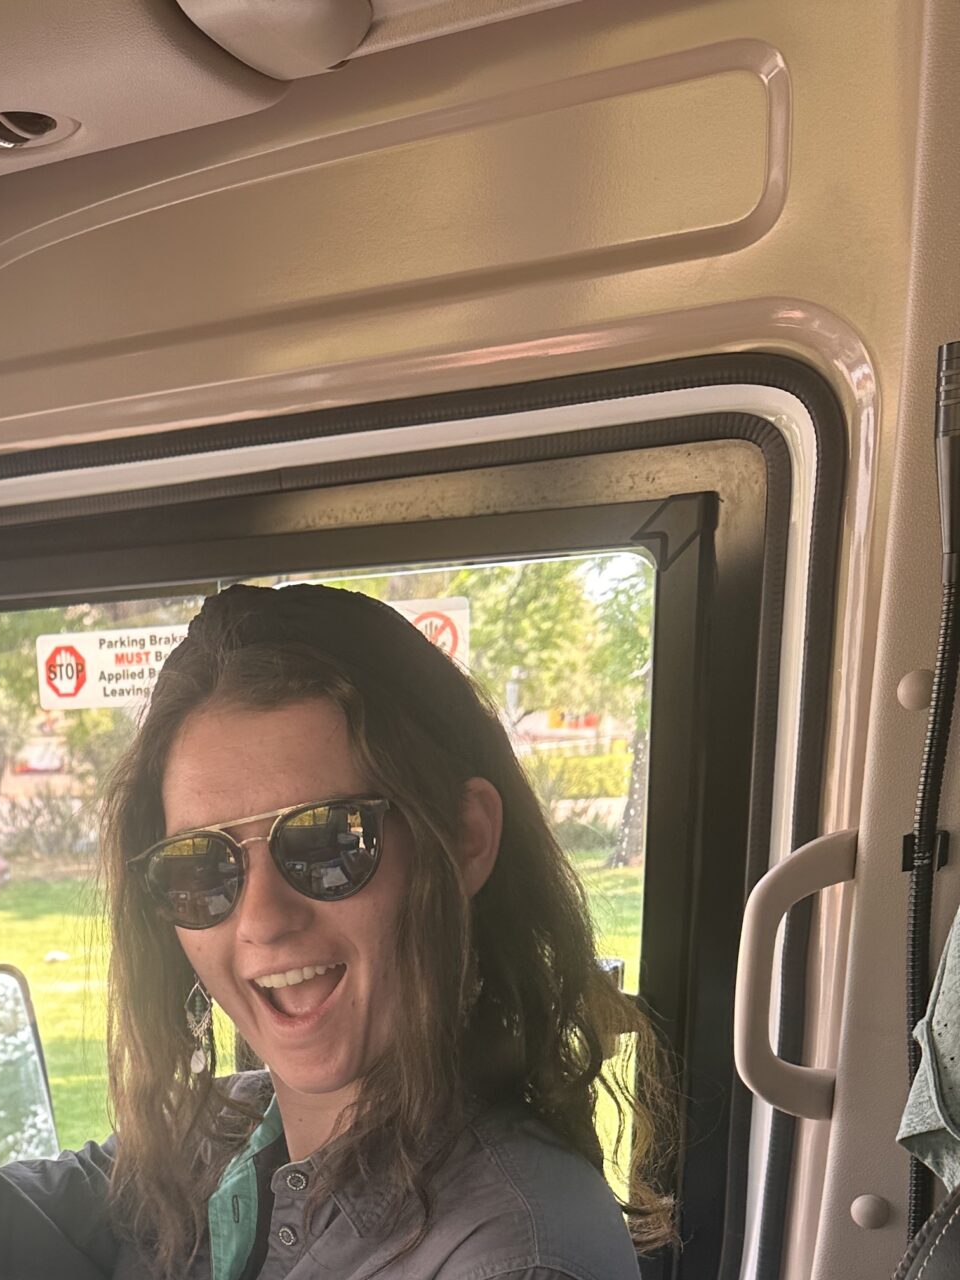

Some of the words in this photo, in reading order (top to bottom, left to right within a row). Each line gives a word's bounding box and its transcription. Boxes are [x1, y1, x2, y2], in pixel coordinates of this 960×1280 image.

[99, 636, 146, 649] Parking
[114, 651, 151, 666] MUST
[47, 662, 85, 682] STOP
[98, 668, 145, 683] Applied
[102, 684, 151, 699] Leaving
